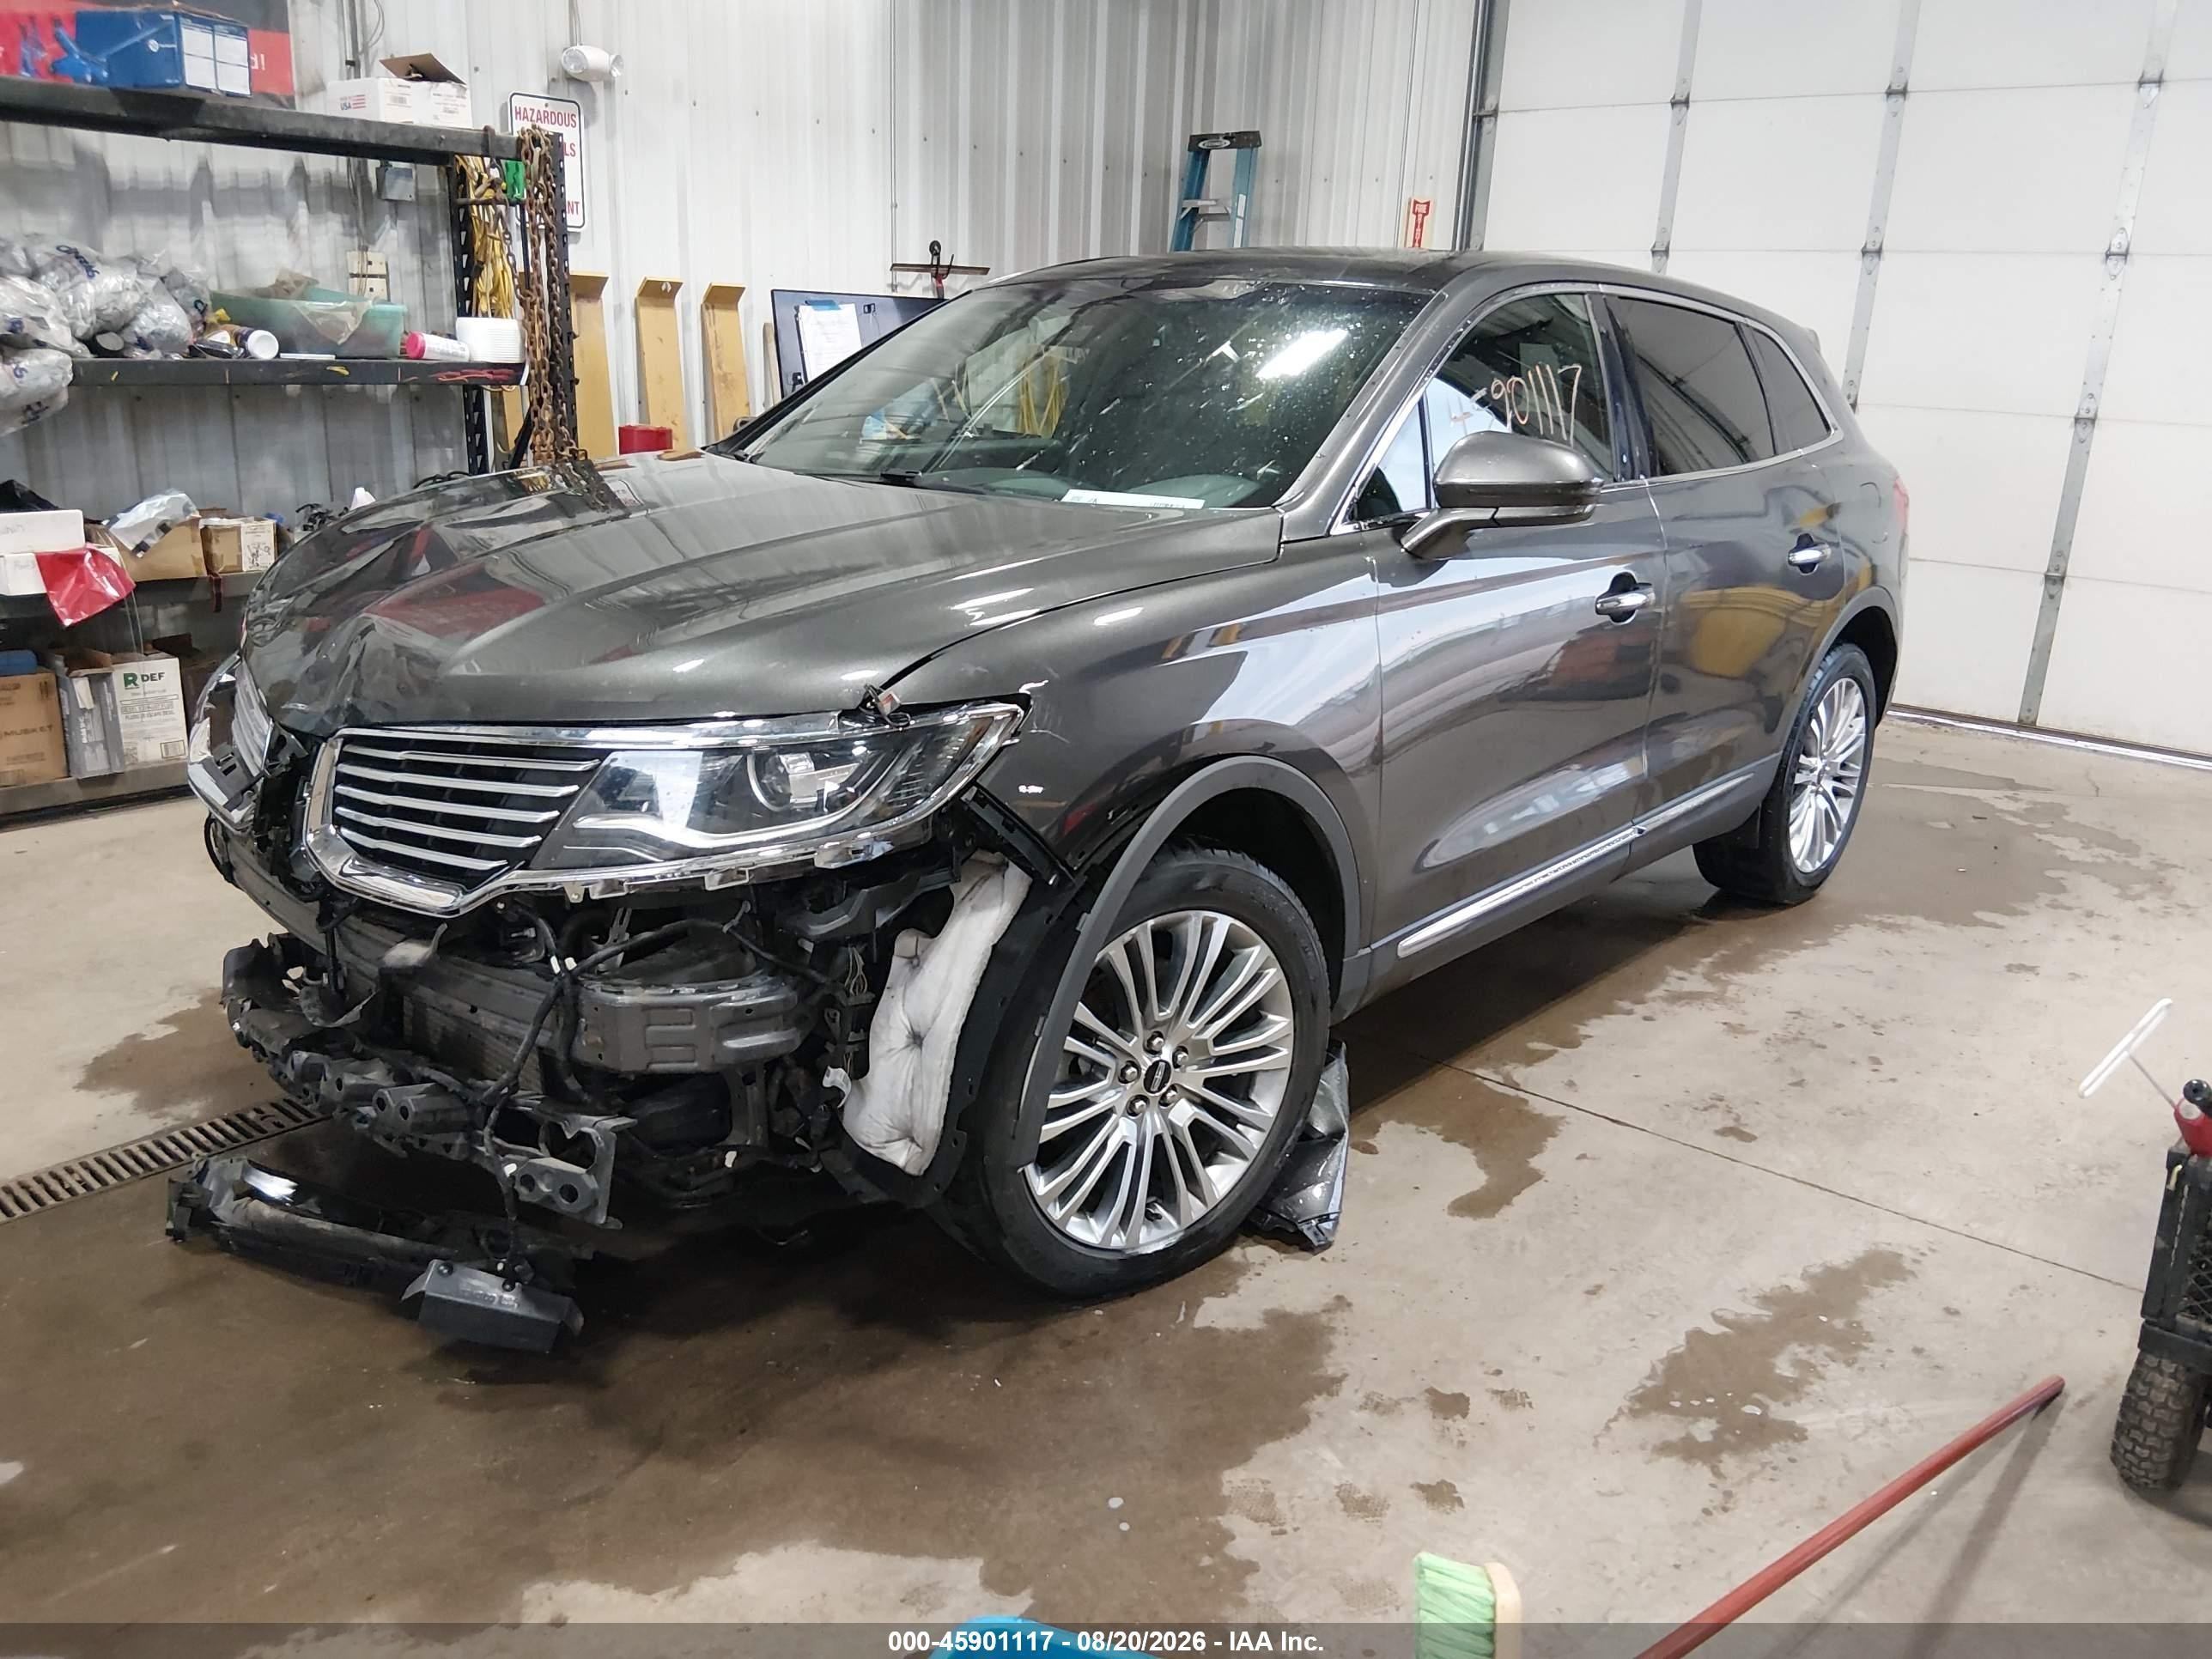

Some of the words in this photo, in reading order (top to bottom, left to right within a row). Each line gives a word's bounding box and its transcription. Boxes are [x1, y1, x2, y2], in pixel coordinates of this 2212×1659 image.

[514, 106, 577, 128] HAZARDOUS
[563, 142, 576, 157] LS
[567, 201, 580, 216] NT
[123, 672, 139, 688] R
[141, 672, 166, 683] DEF
